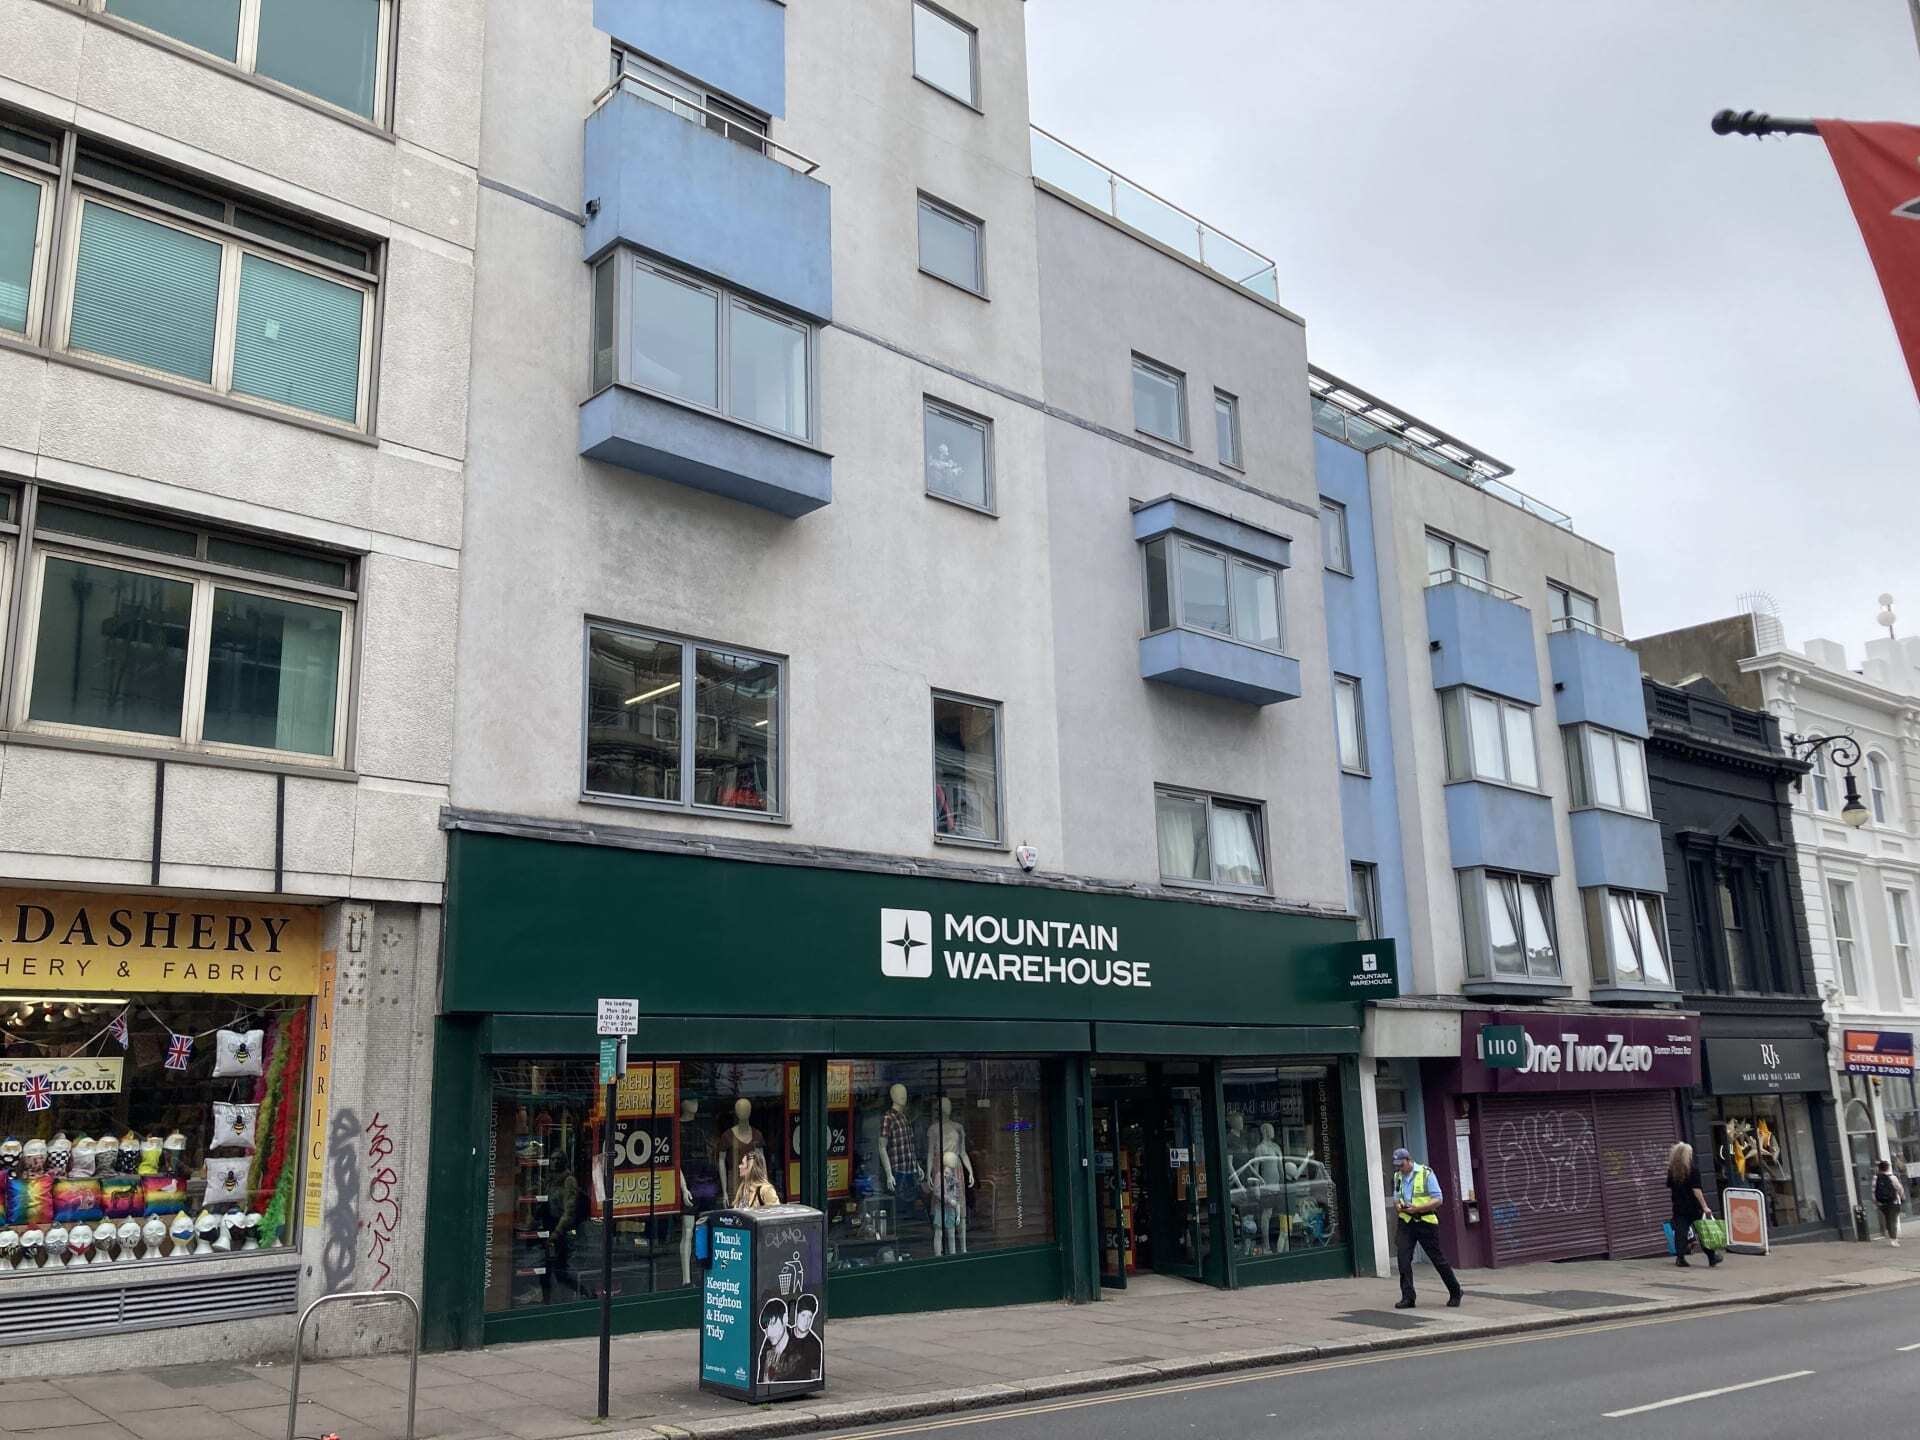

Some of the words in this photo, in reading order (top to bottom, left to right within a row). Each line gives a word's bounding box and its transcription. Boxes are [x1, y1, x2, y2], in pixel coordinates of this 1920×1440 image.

[0, 904, 291, 953] DASHERY
[944, 912, 1118, 951] MOUNTAIN
[116, 960, 130, 978] &
[163, 961, 283, 983] FABRIC
[943, 950, 1152, 987] WAREHOUSE
[1352, 972, 1389, 980] MOUNTAIN
[1349, 978, 1393, 987] WAREHOUSE
[1849, 1054, 1879, 1063] OFFICE
[1880, 1056, 1894, 1064] TO
[1895, 1056, 1910, 1065] LET
[1849, 1064, 1876, 1072] 01273
[313, 980, 331, 1161] FABRIC
[654, 1155, 670, 1164] OFF
[614, 1175, 662, 1193] HUGE
[714, 1231, 741, 1246] Thank
[714, 1248, 730, 1261] you
[730, 1248, 743, 1261] for
[706, 1276, 740, 1295] Keeping
[706, 1292, 742, 1309] Brighton
[706, 1310, 713, 1321] &
[713, 1309, 735, 1324] Hove
[706, 1324, 725, 1341] Tidy
